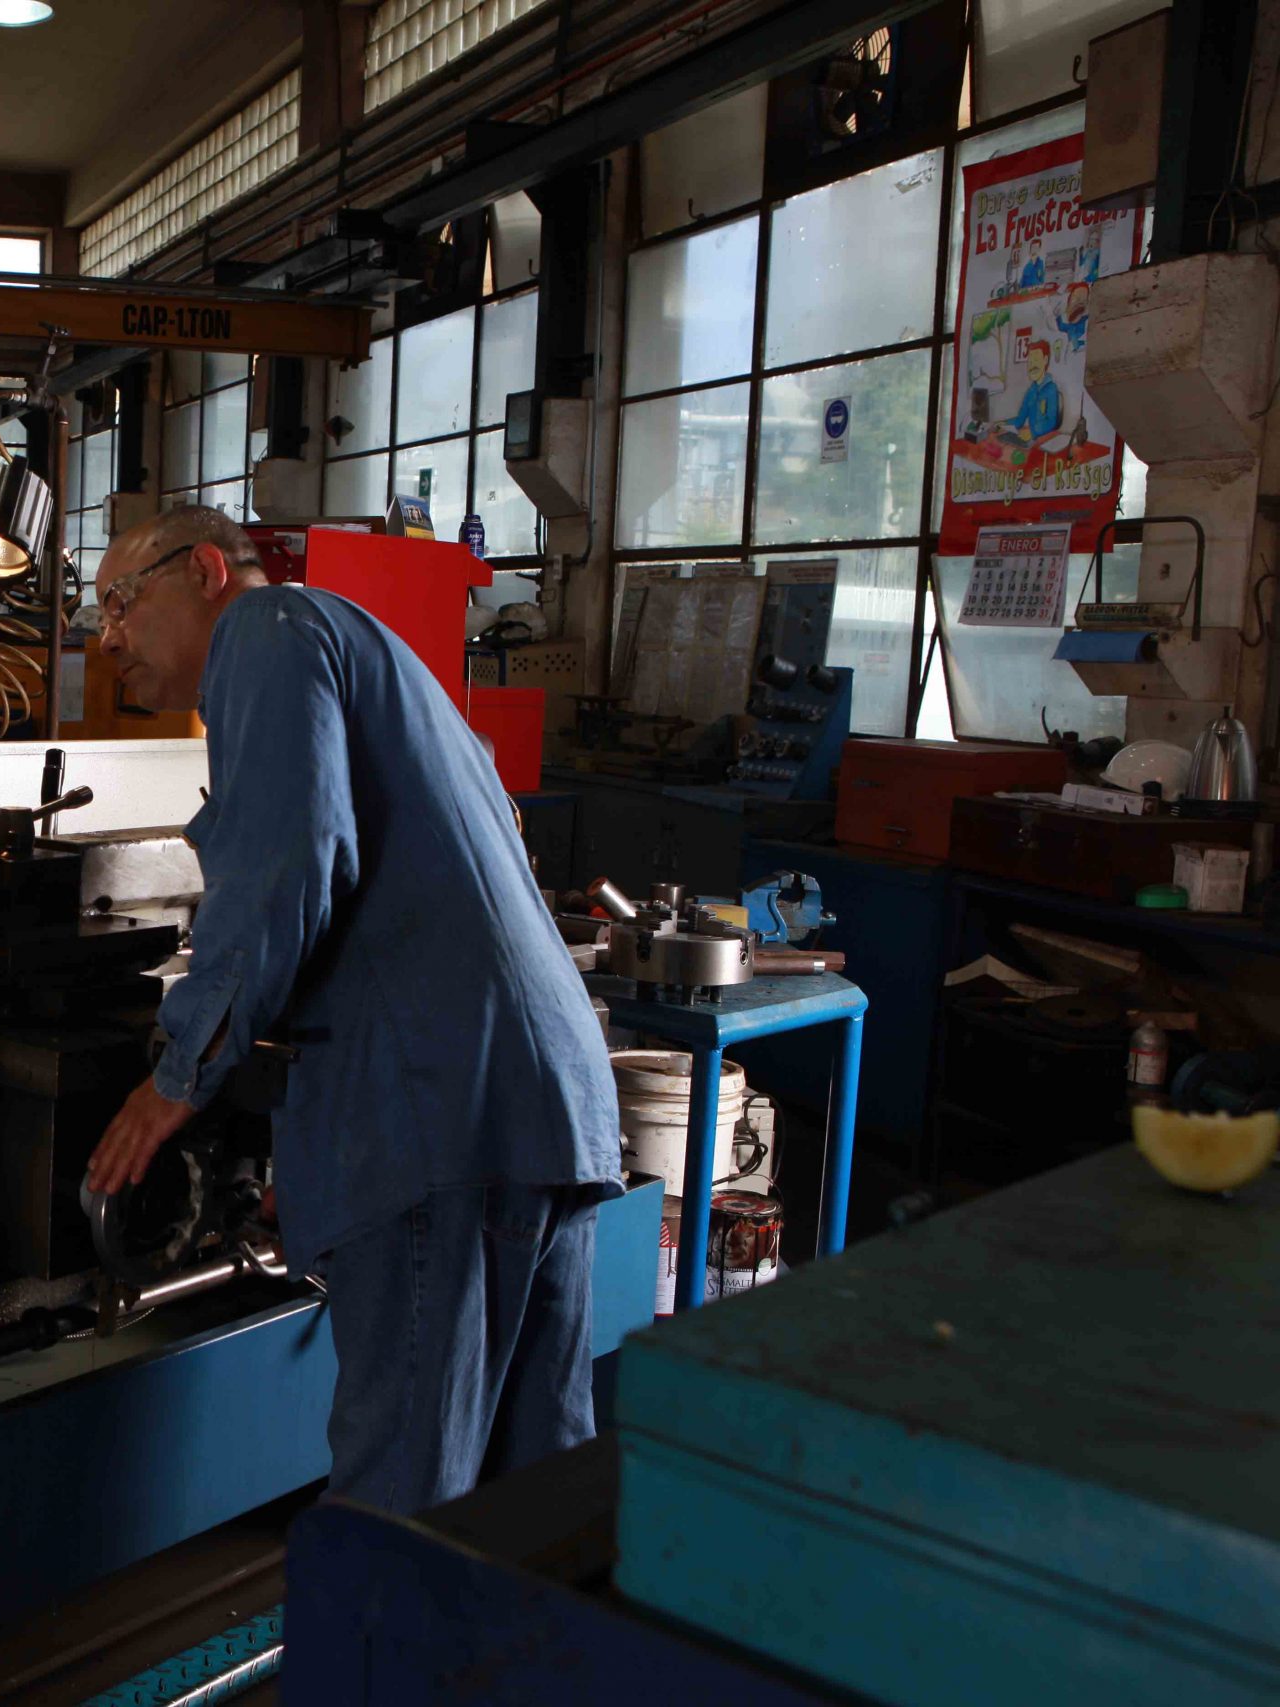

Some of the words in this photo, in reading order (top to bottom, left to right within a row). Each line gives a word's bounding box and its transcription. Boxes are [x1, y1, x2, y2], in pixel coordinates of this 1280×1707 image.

[977, 185, 1029, 219] Darse
[975, 221, 998, 255] La
[1017, 336, 1030, 360] 13
[951, 467, 1025, 506] Disminuye
[1032, 452, 1047, 491] el
[1055, 458, 1112, 501] Riesgo
[1001, 539, 1039, 552] ENERO
[1038, 558, 1044, 567] 2
